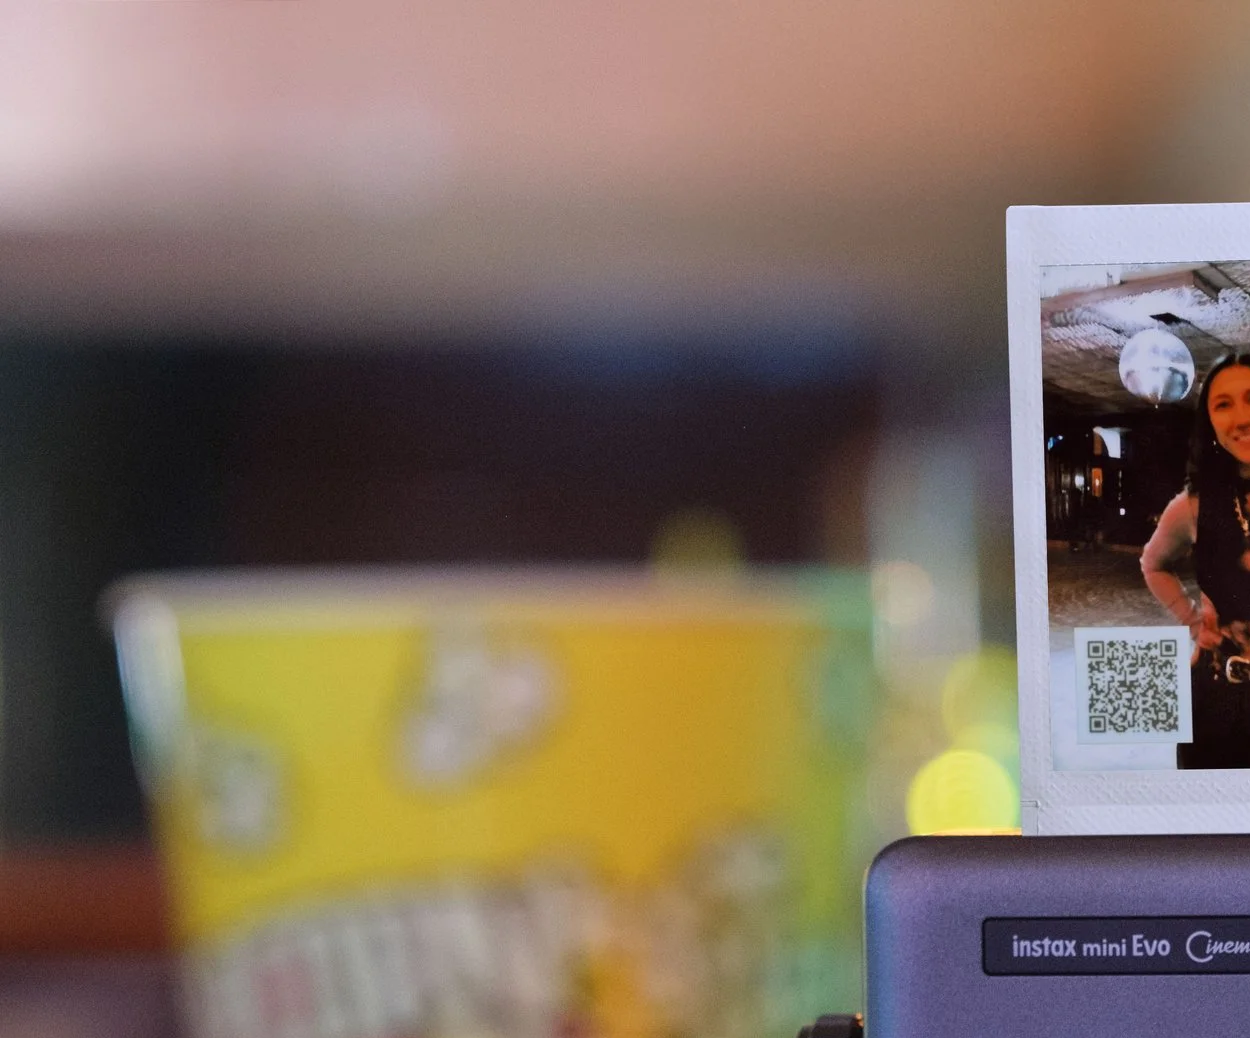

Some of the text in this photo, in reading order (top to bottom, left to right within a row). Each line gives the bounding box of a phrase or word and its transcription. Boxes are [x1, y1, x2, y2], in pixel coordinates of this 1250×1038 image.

[1012, 934, 1076, 957] instax
[1082, 938, 1127, 957] mini
[1132, 934, 1171, 957] Evo
